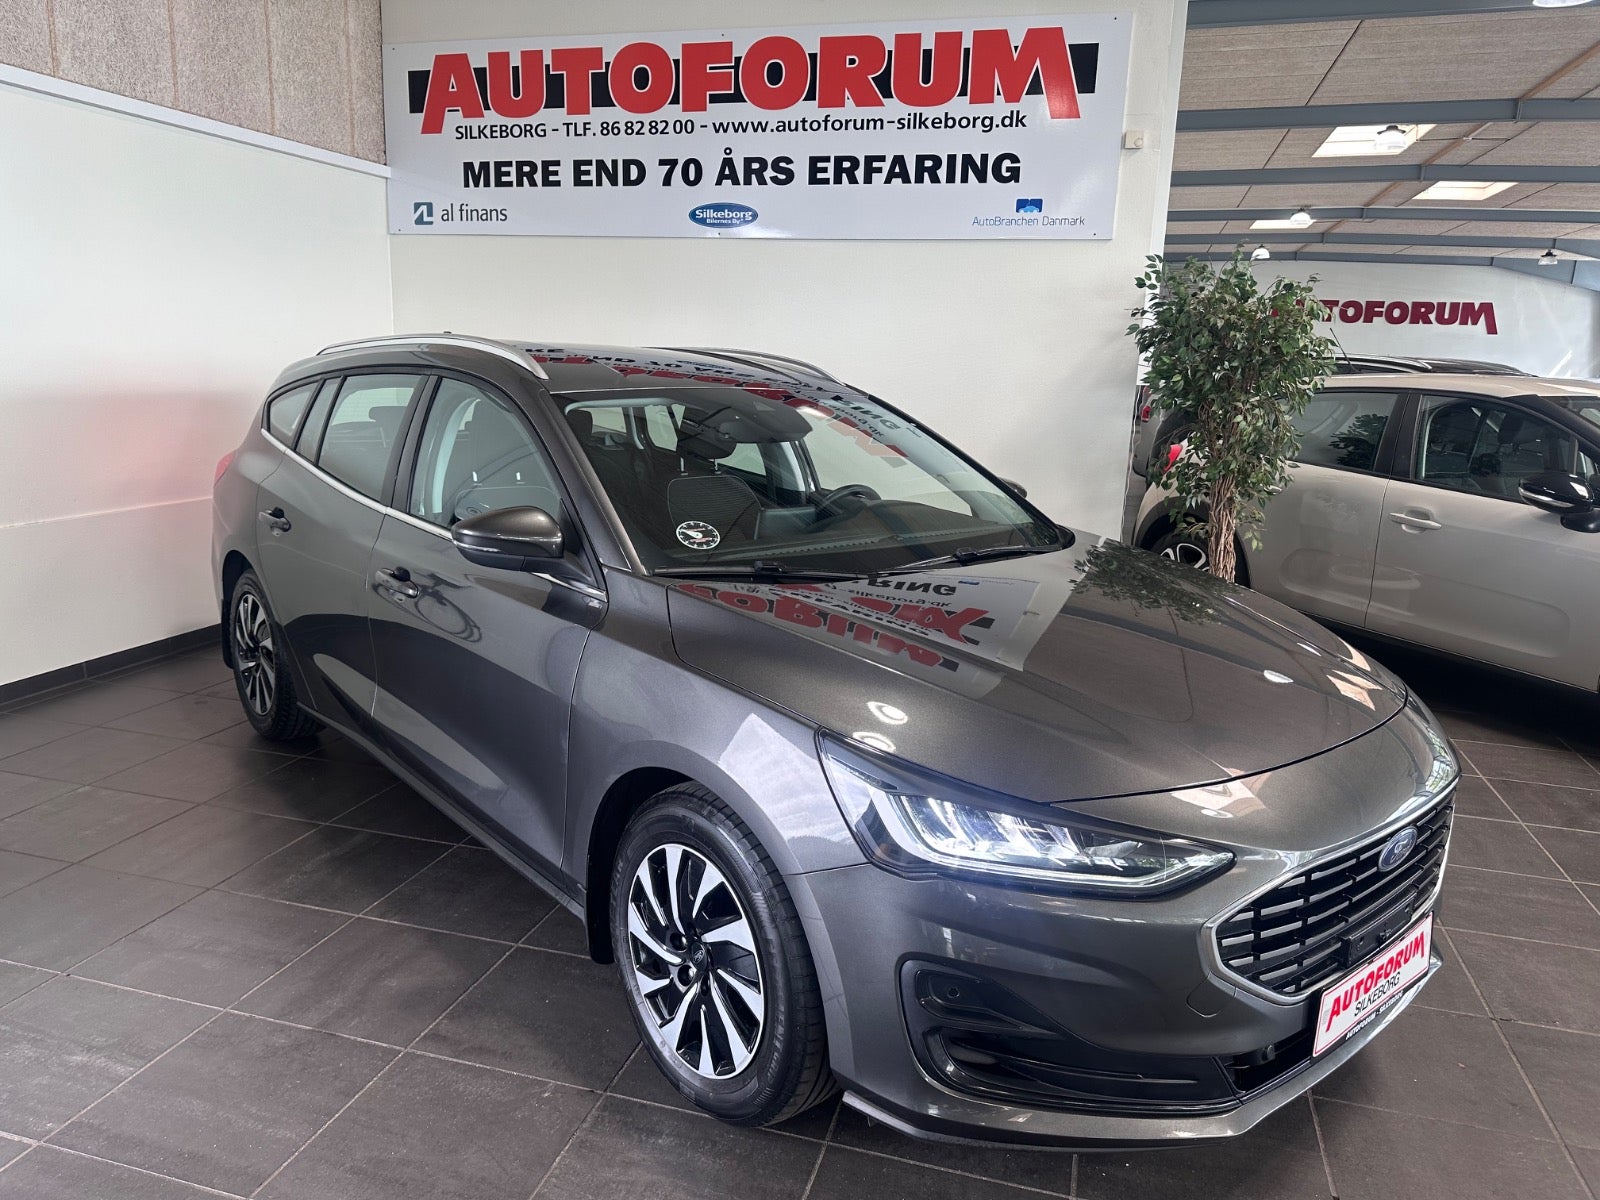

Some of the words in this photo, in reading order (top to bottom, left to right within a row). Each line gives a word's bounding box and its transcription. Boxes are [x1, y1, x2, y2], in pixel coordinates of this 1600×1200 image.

[421, 27, 1081, 134] AUTOFORUM
[455, 123, 547, 140] SILKEBORG
[563, 122, 596, 137] TLF.
[712, 110, 1027, 134] www.autoforum-silkeborg.dk
[463, 159, 561, 188] MERE
[573, 159, 647, 187] END
[658, 157, 703, 187] 70
[714, 146, 795, 186] ÅRS
[808, 152, 1021, 185] ERFARING
[441, 203, 454, 221] al
[459, 203, 508, 222] finans
[695, 208, 753, 221] Silkeborg
[971, 216, 1039, 227] AutoBranchen
[1042, 215, 1086, 226] Danmark
[1325, 931, 1425, 1033] AUTOFORUM
[1354, 971, 1401, 1017] SILKEBORG
